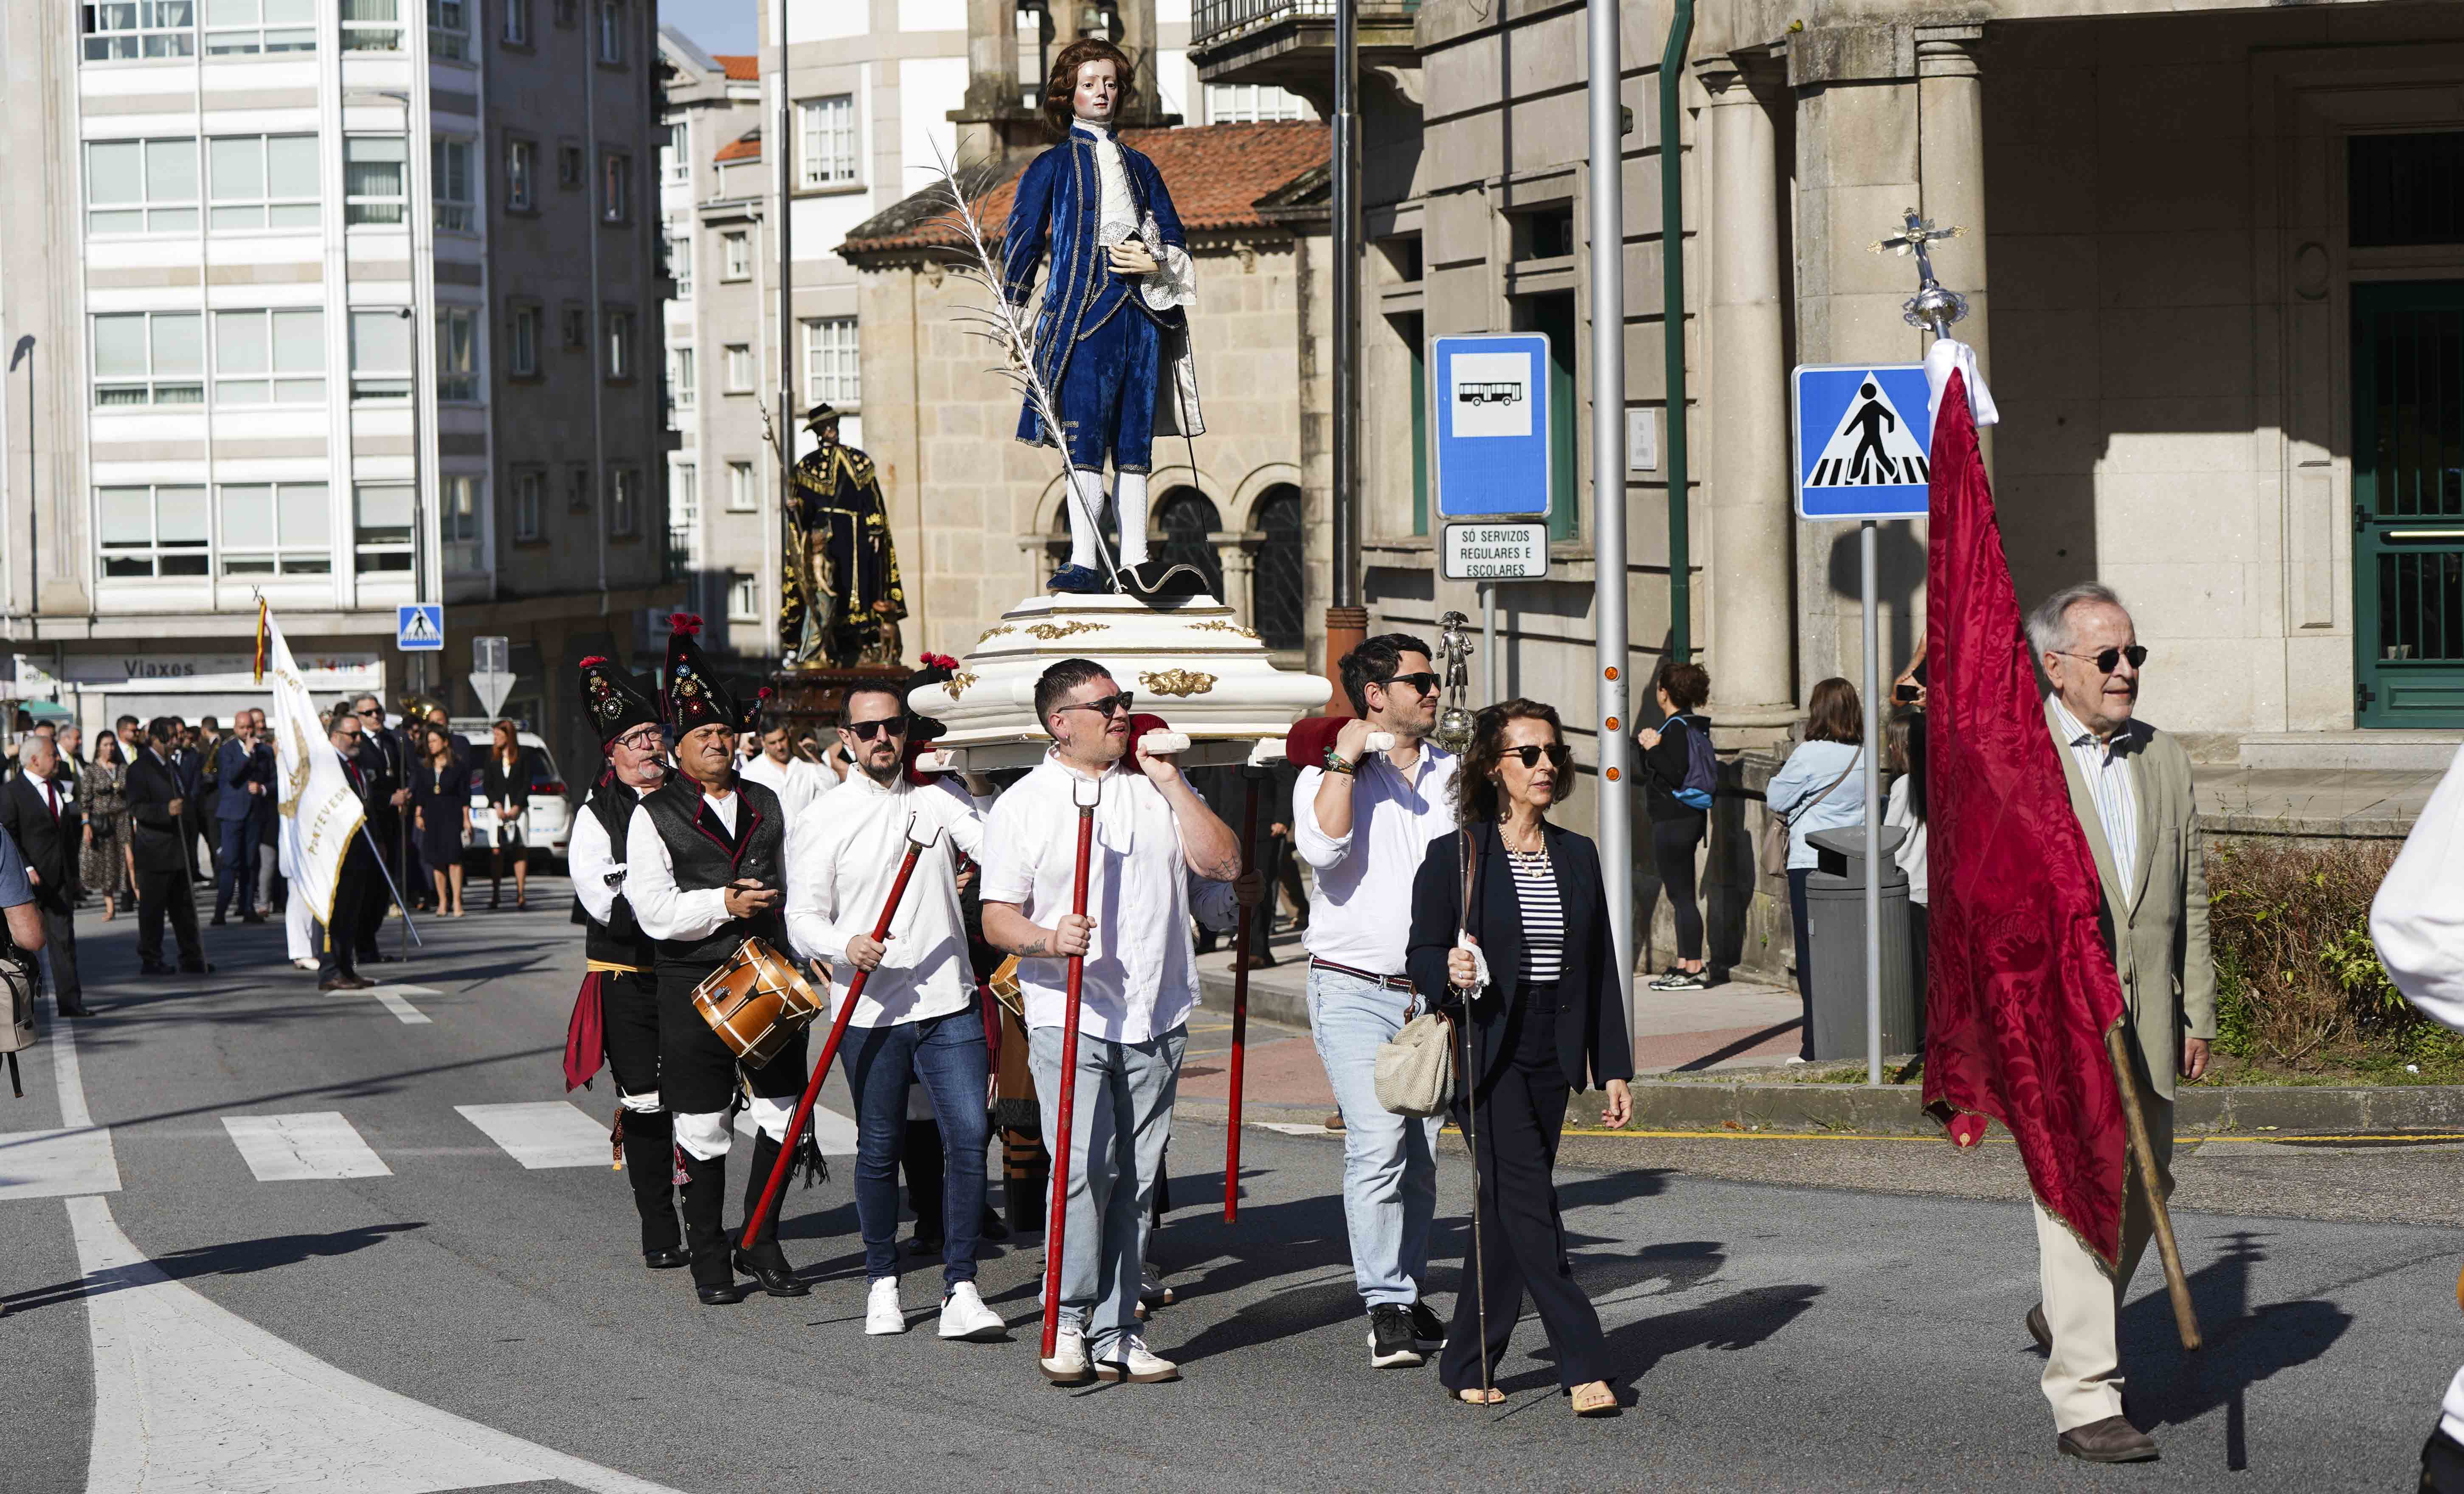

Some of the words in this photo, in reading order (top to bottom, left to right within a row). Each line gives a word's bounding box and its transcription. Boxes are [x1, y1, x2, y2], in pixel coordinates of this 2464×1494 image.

[1462, 528, 1475, 542] SÓ
[1481, 530, 1530, 542] SERVIZOS
[1461, 548, 1520, 559] REGULARES
[1526, 547, 1531, 559] E
[1467, 564, 1525, 576] ESCOLARES
[124, 659, 195, 676] Viaxes
